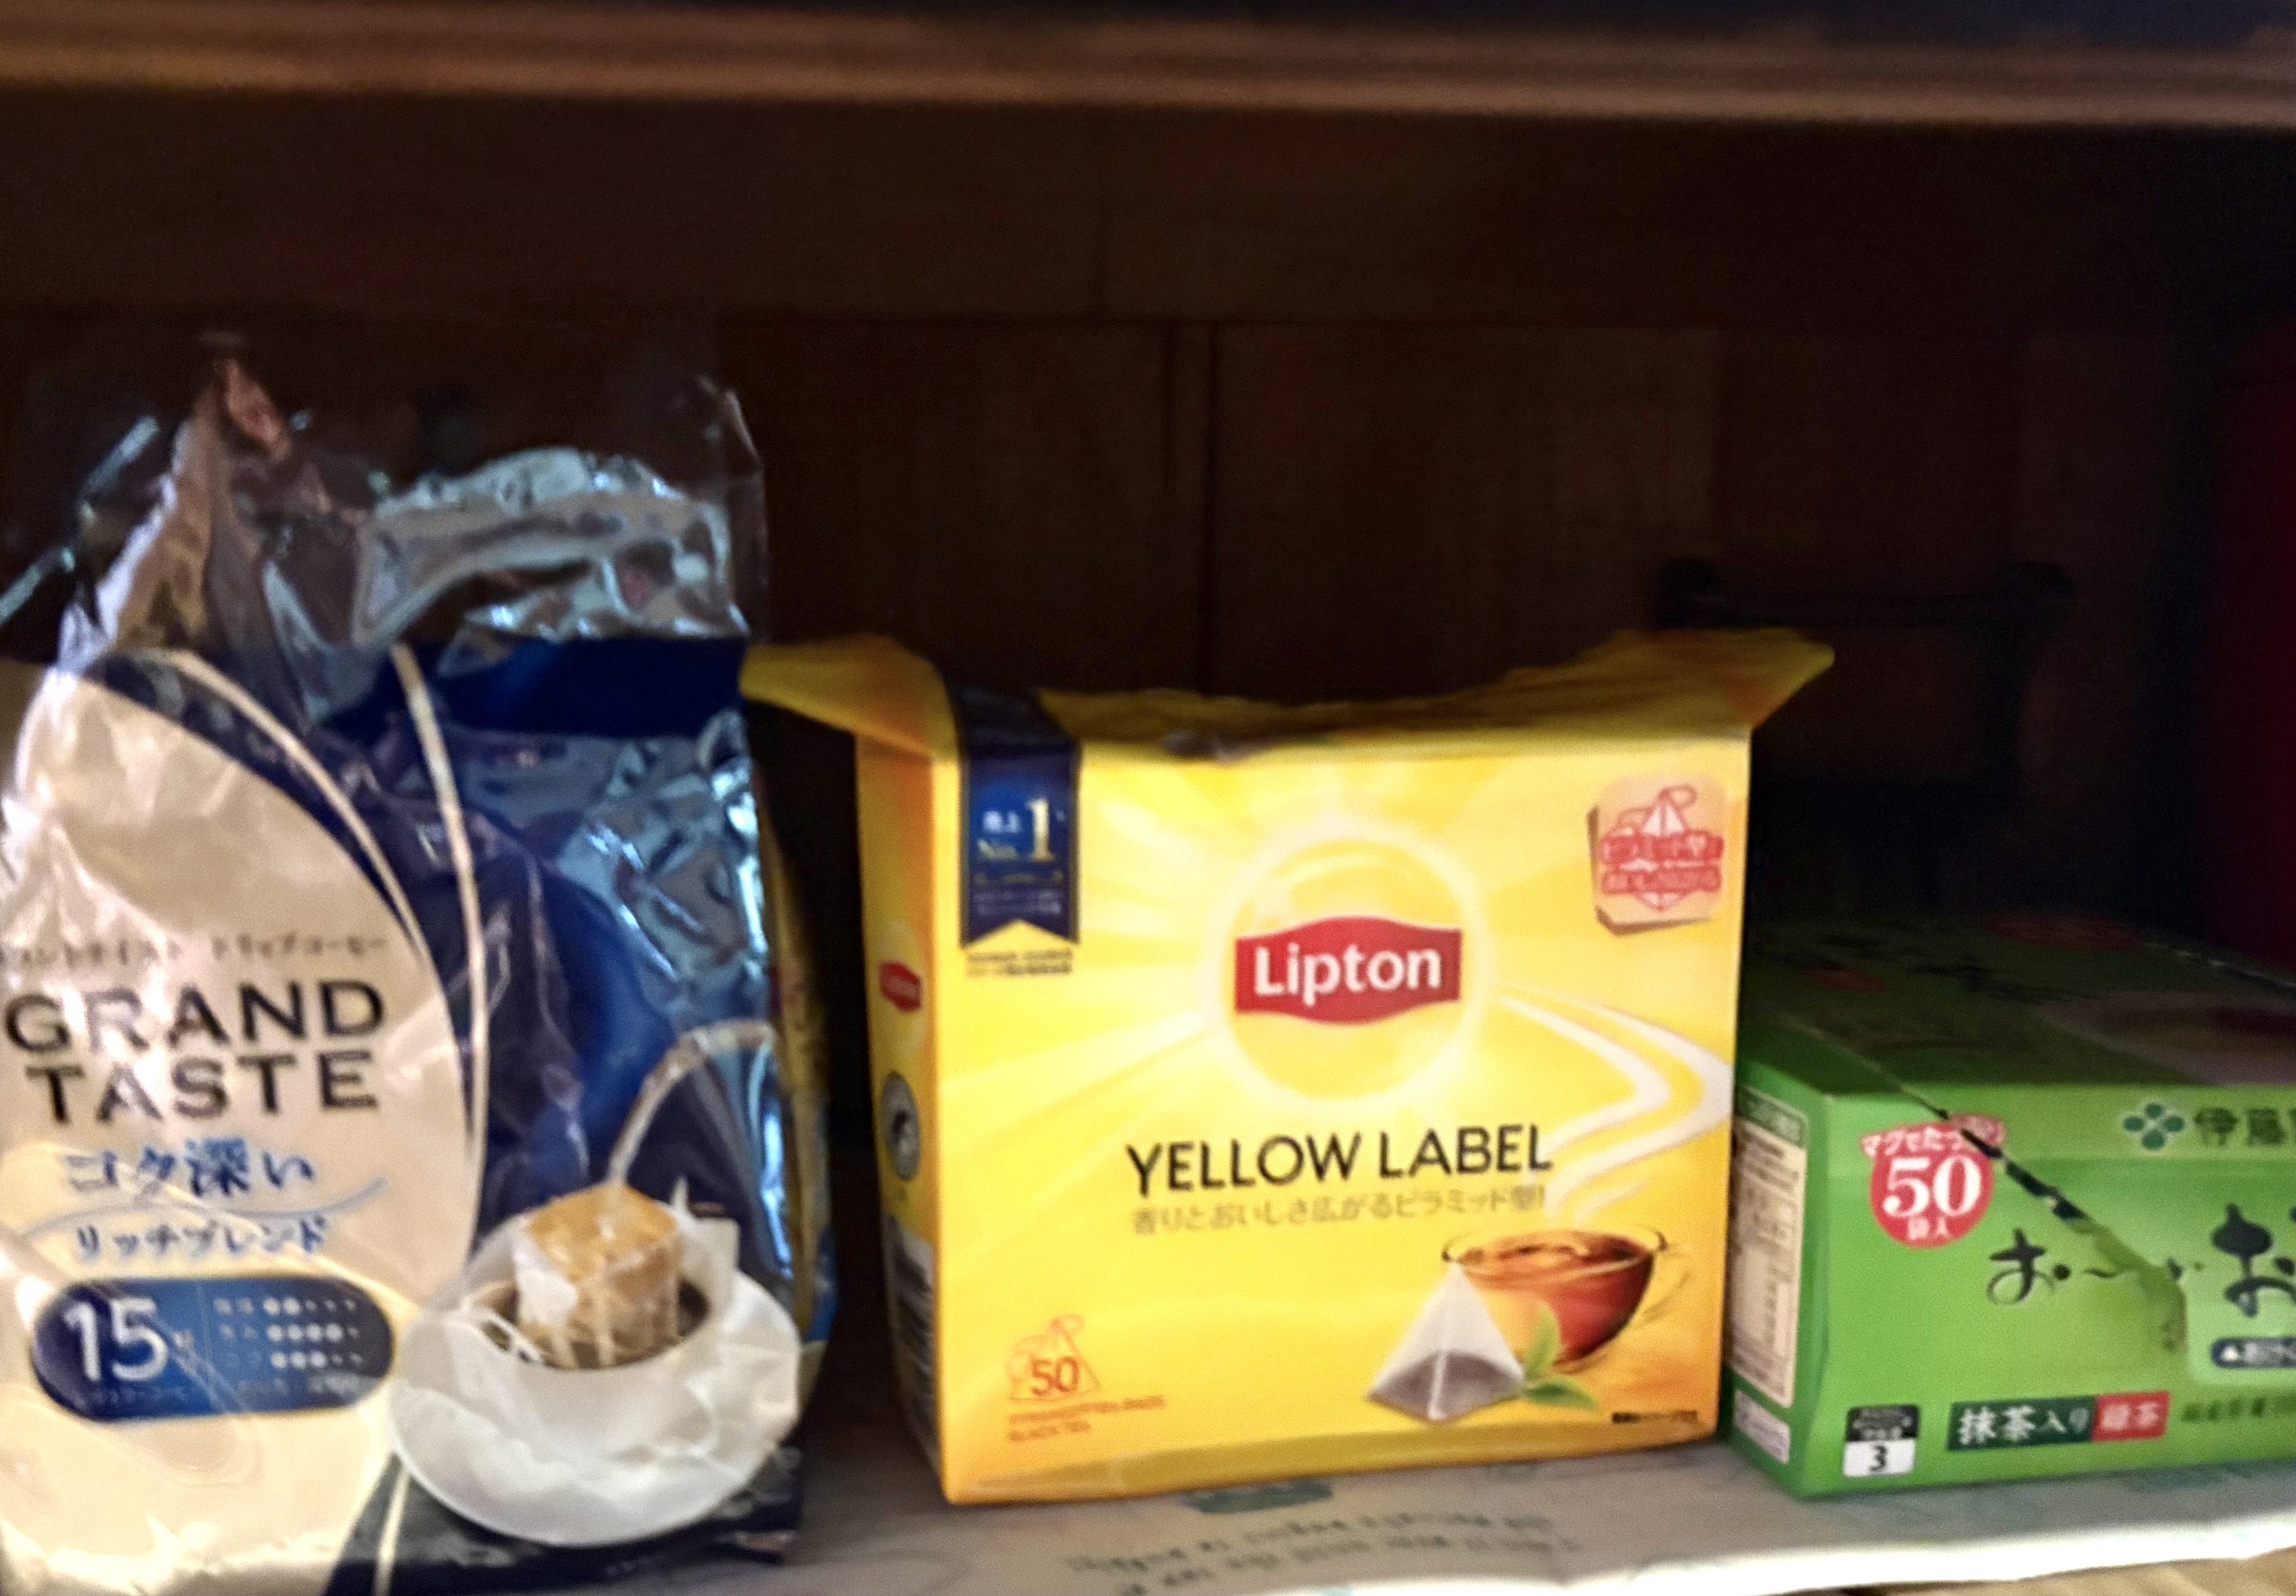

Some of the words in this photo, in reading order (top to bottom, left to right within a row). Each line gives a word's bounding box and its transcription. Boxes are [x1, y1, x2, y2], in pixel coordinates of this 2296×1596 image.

[1254, 942, 1441, 1006] Lipton
[4, 979, 384, 1053] GRAND
[25, 1050, 380, 1125] TASTE
[2193, 1106, 2296, 1148] 伊藤
[1126, 1130, 1363, 1199] YELLOW
[1379, 1123, 1554, 1180] LABEL
[1882, 1155, 1982, 1218] 50
[1029, 1355, 1080, 1396] 50
[1869, 1445, 1887, 1471] 3
